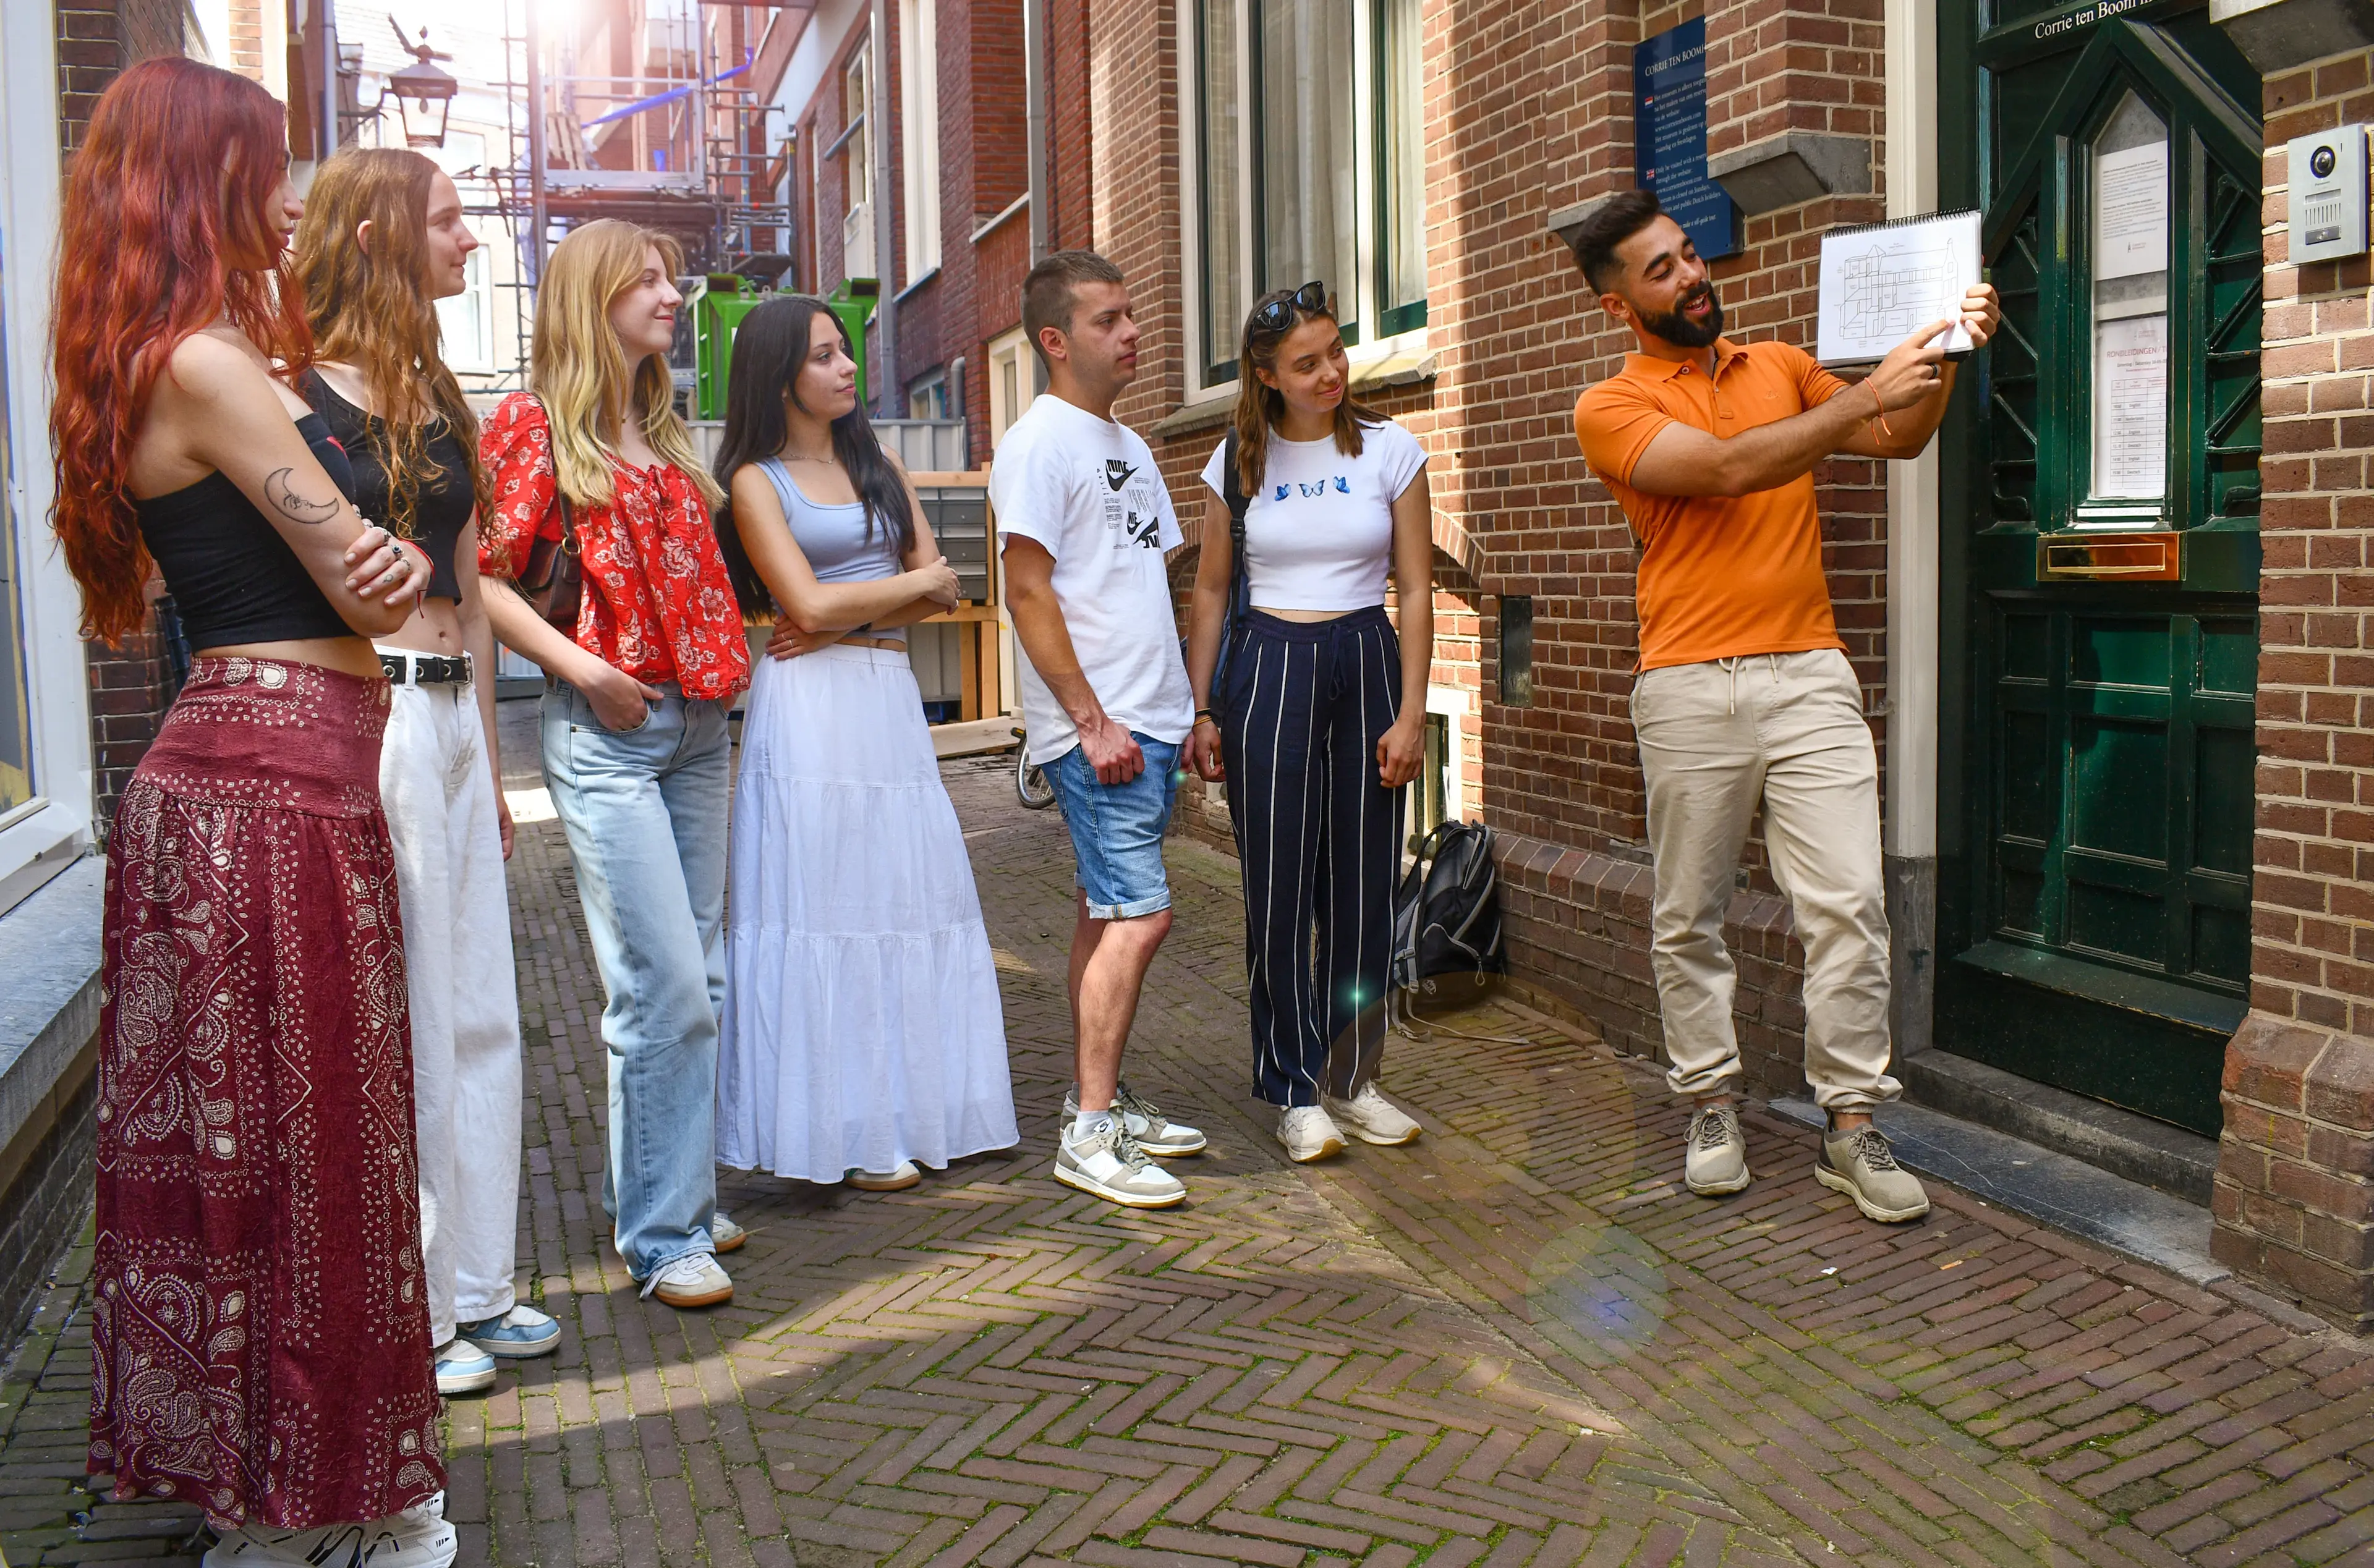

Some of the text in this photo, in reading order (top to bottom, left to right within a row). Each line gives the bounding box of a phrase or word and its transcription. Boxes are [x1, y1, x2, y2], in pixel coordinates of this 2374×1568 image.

[2035, 0, 2137, 39] Corrie ten Boom
[1645, 59, 1668, 77] CORRIE
[1669, 54, 1681, 67] TEN
[2107, 347, 2157, 358] RONDLEIDINGEN
